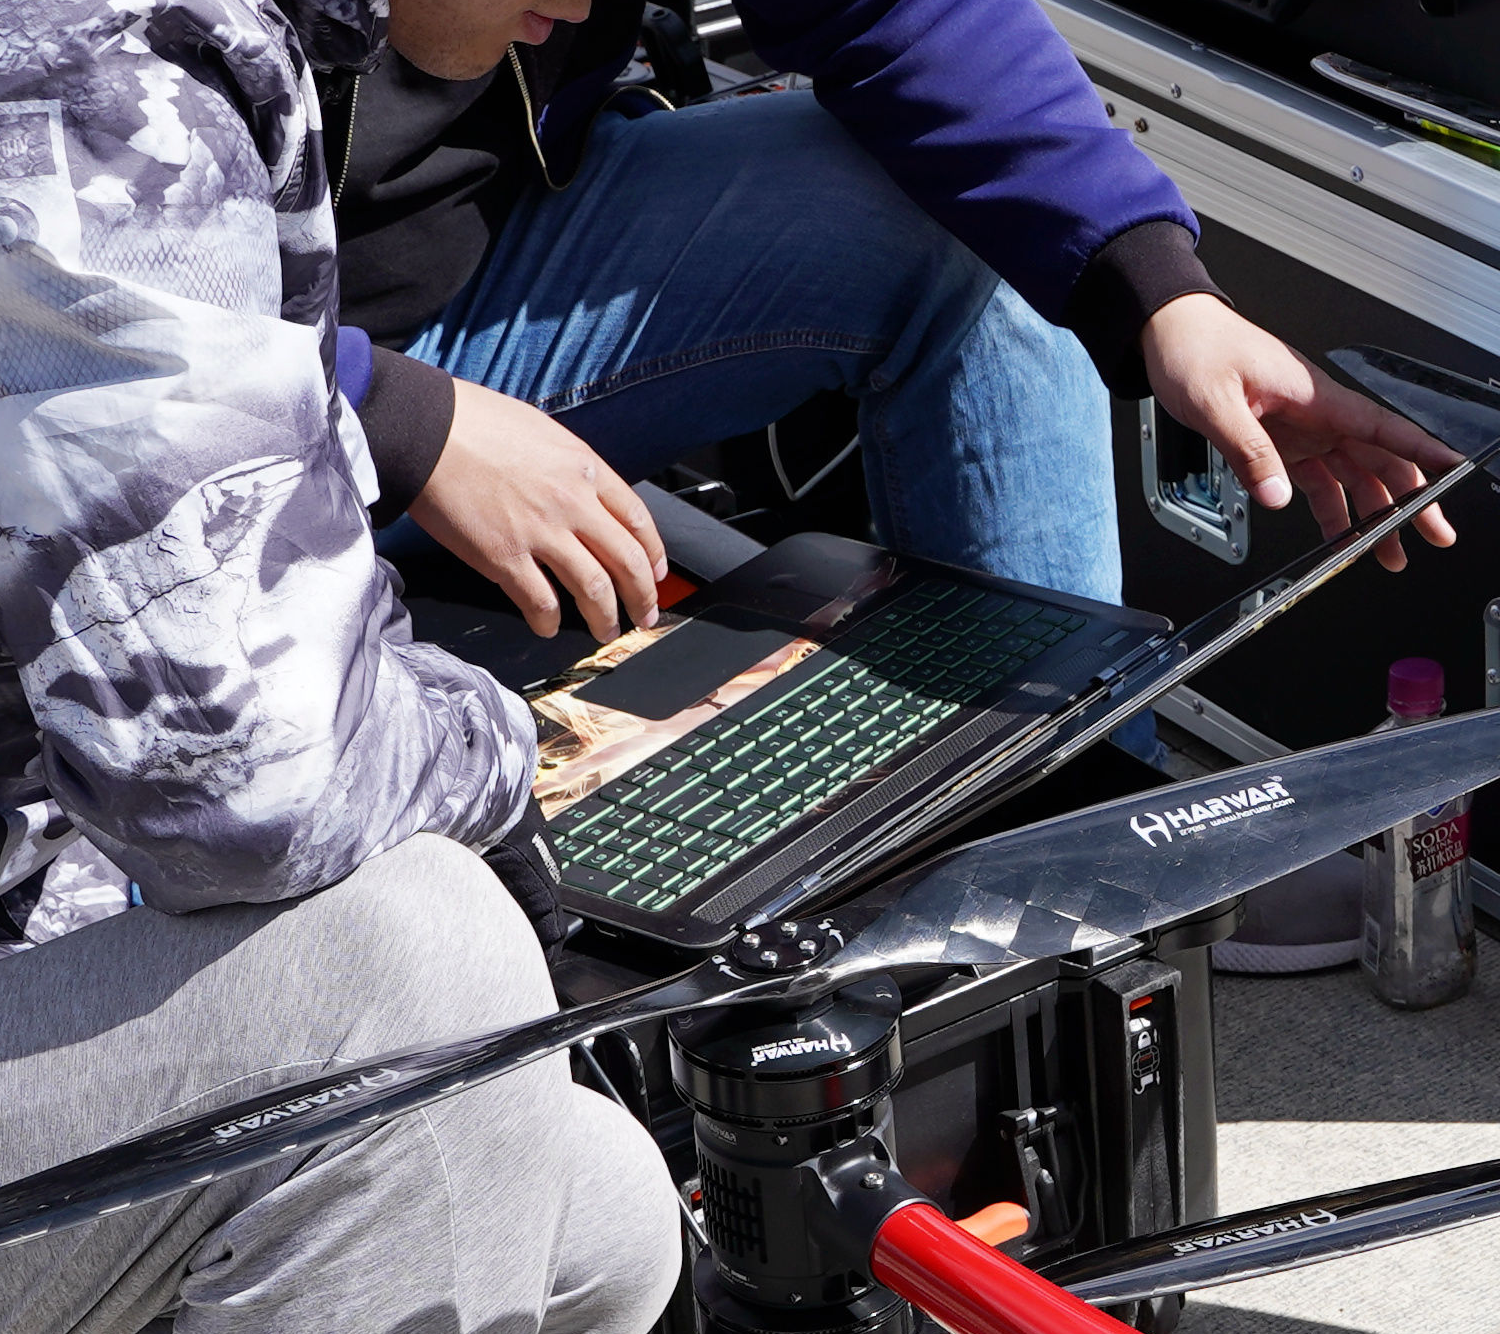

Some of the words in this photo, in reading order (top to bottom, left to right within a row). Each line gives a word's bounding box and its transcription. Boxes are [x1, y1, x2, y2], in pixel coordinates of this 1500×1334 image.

[1164, 782, 1290, 828] HARWAR
[1210, 798, 1295, 827] www.harwar.com
[1412, 821, 1460, 854] SODA
[753, 1040, 830, 1063] HARWAR
[214, 1083, 361, 1139] HARWAR
[1172, 1219, 1302, 1254] HARWAR
